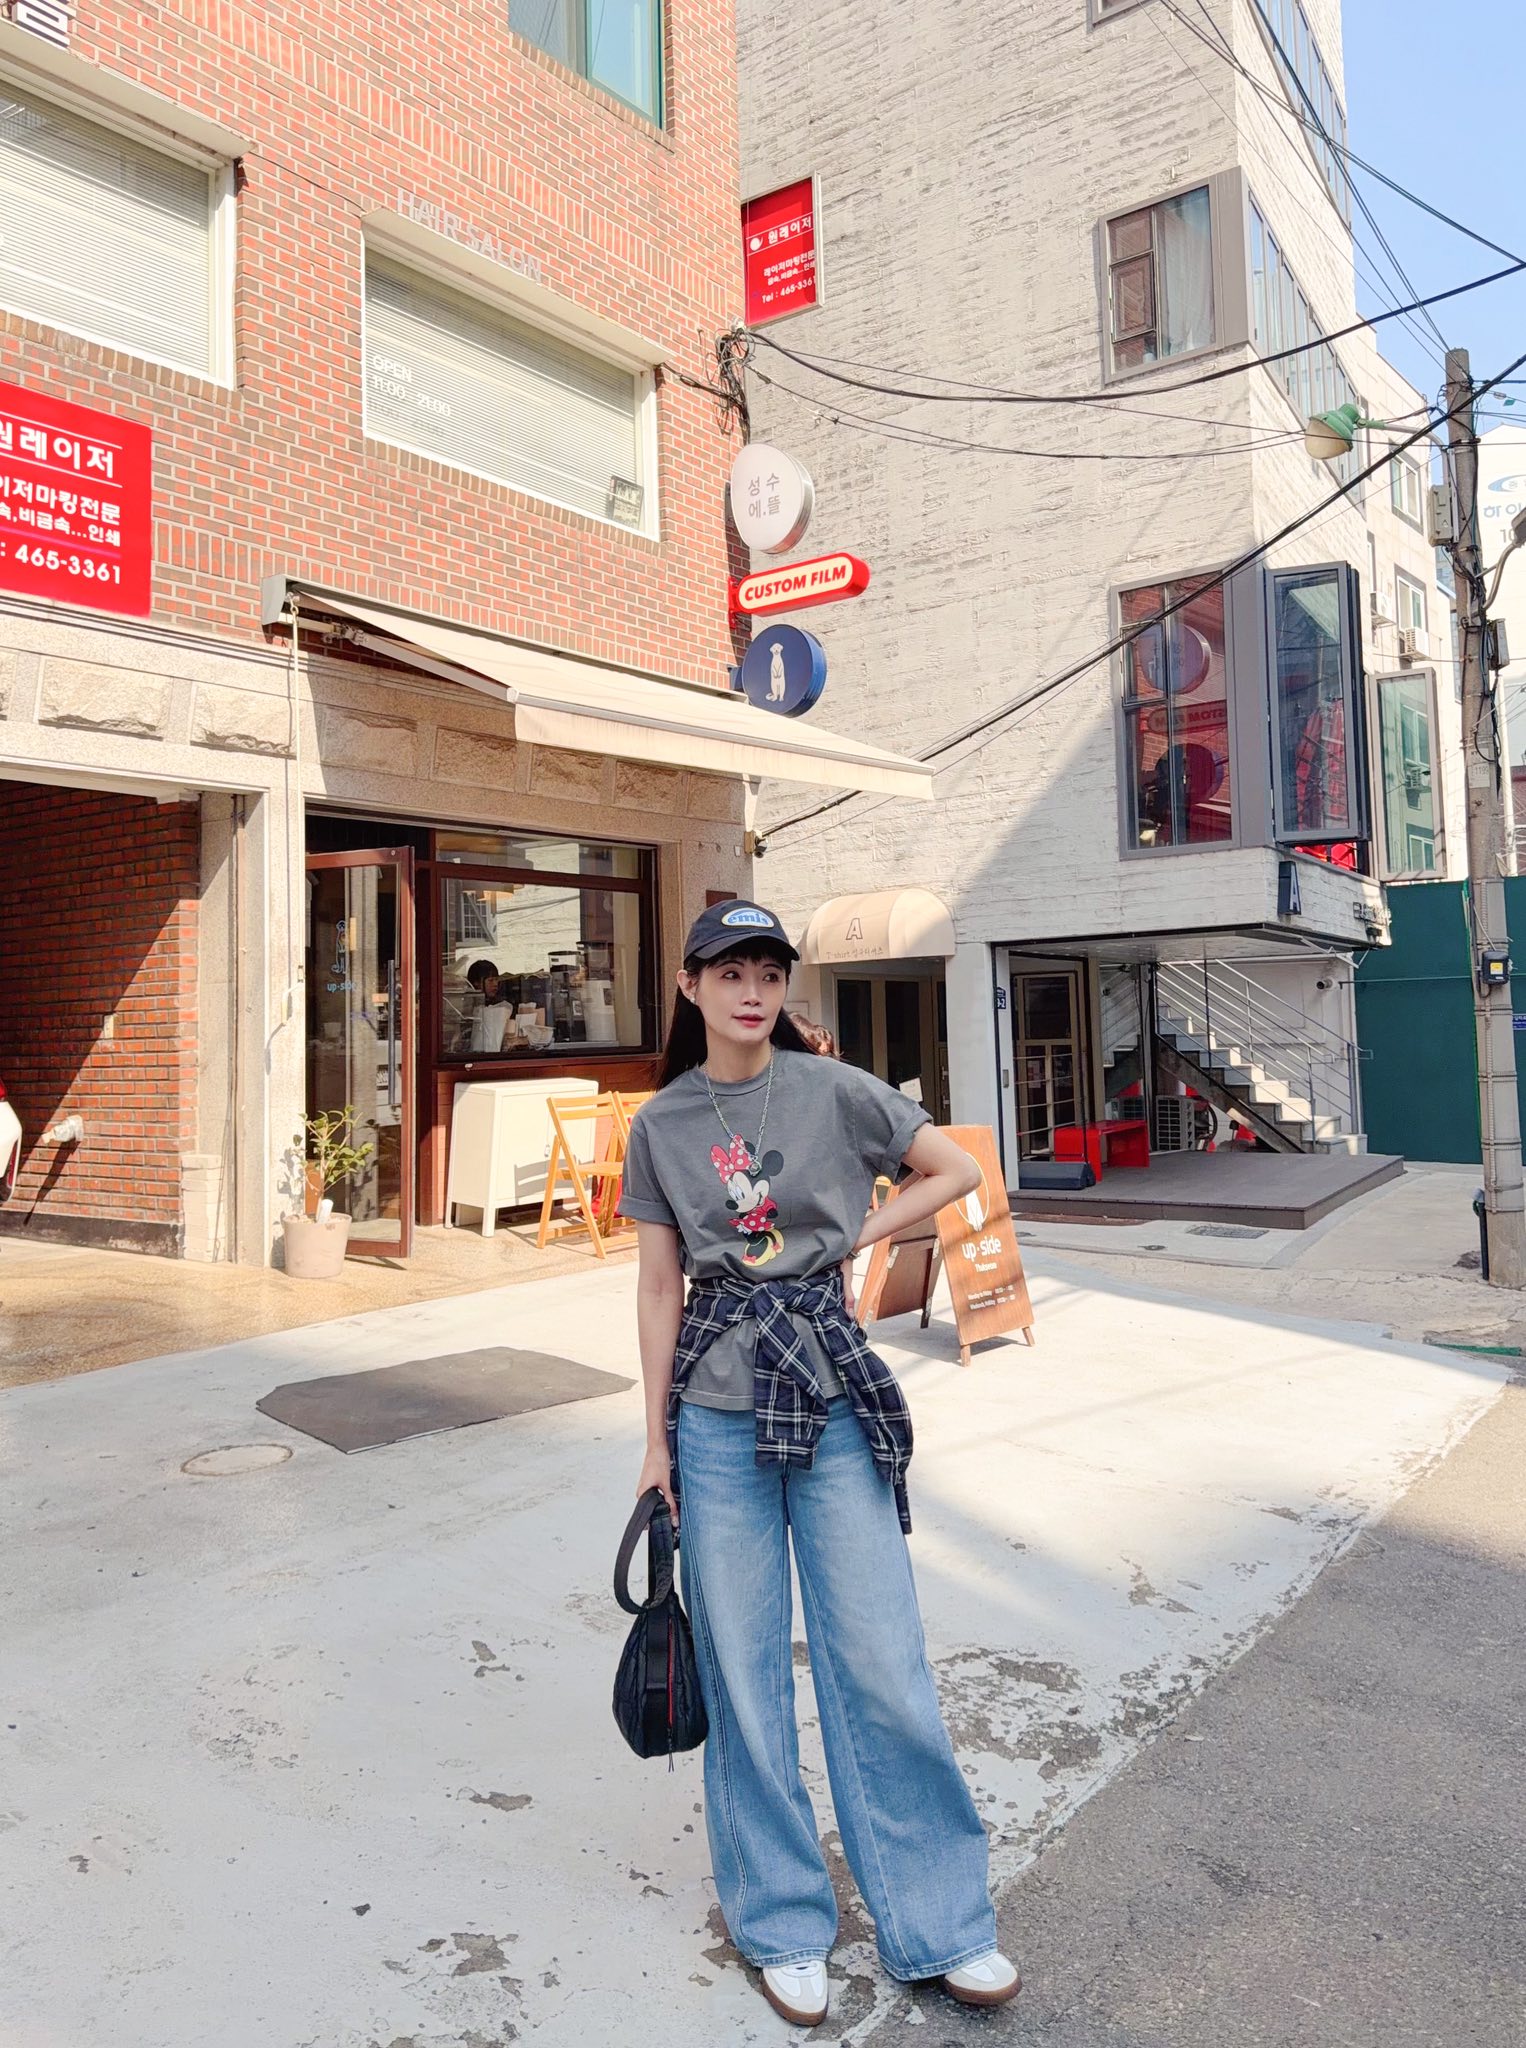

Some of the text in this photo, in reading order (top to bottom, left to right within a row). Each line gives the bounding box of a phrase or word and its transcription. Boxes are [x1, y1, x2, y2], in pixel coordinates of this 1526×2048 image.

[397, 187, 541, 284] HAIR SALON
[768, 216, 811, 244] 원레이저
[373, 355, 412, 382] OPEN
[15, 544, 120, 585] 465-3361
[744, 564, 847, 602] CUSTOM FILM
[846, 918, 863, 940] A
